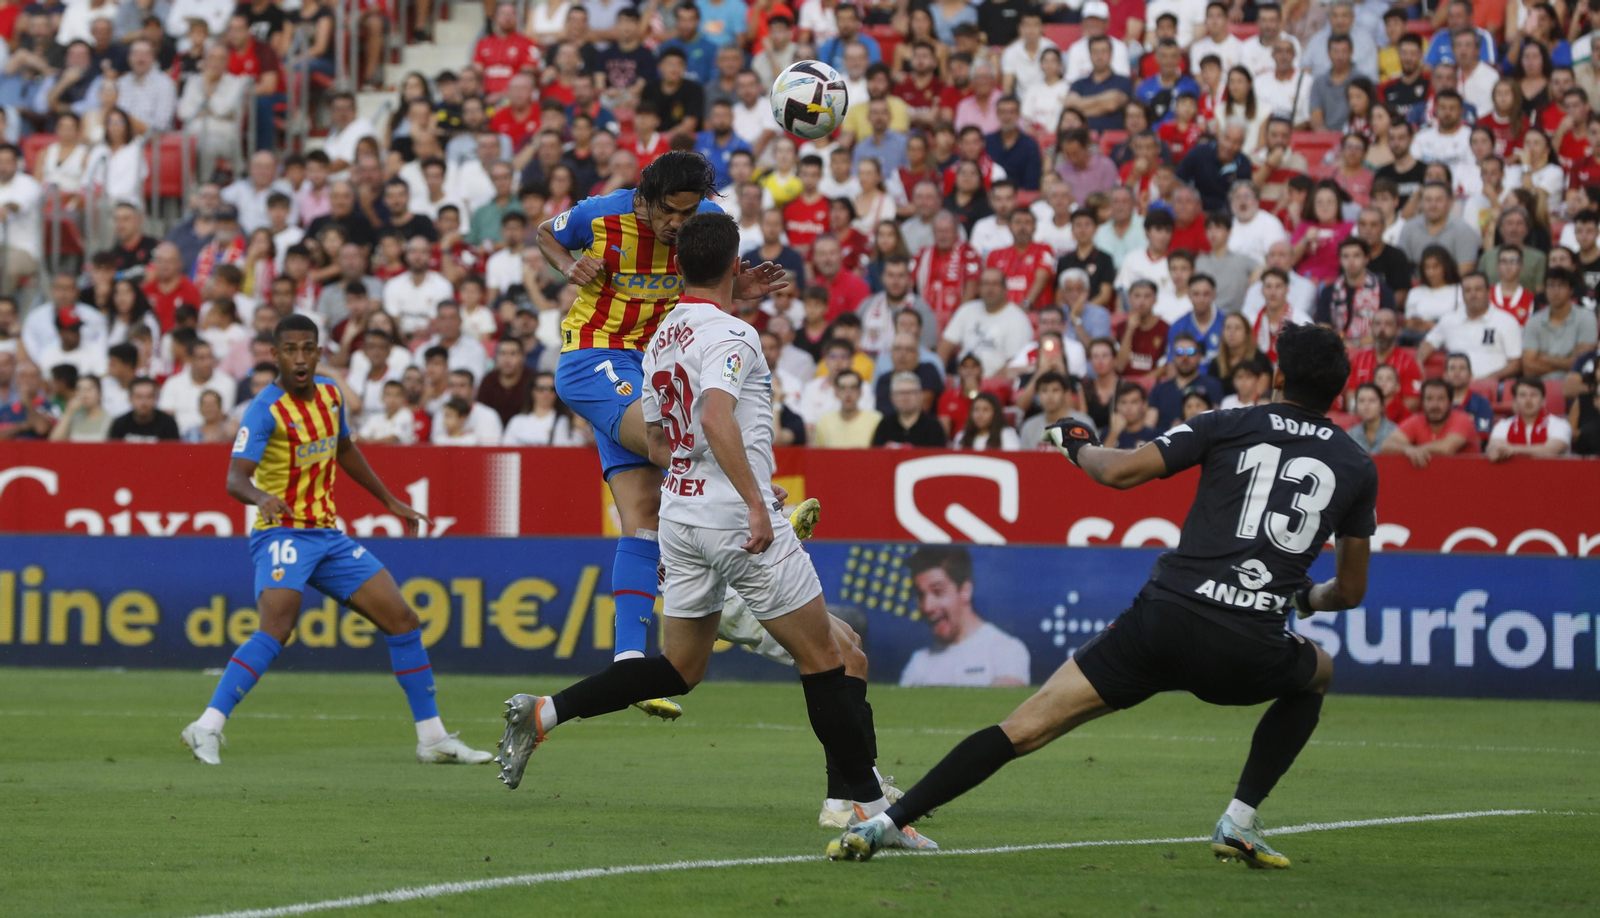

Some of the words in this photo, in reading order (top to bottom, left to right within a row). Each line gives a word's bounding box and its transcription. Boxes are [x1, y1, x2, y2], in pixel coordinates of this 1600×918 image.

[613, 272, 683, 290] CAZO
[593, 359, 620, 383] 7
[1269, 413, 1334, 441] BONO
[1235, 442, 1336, 554] 13
[268, 539, 298, 566] 16
[1194, 579, 1287, 615] ANDEX
[1292, 588, 1600, 670] surfor
